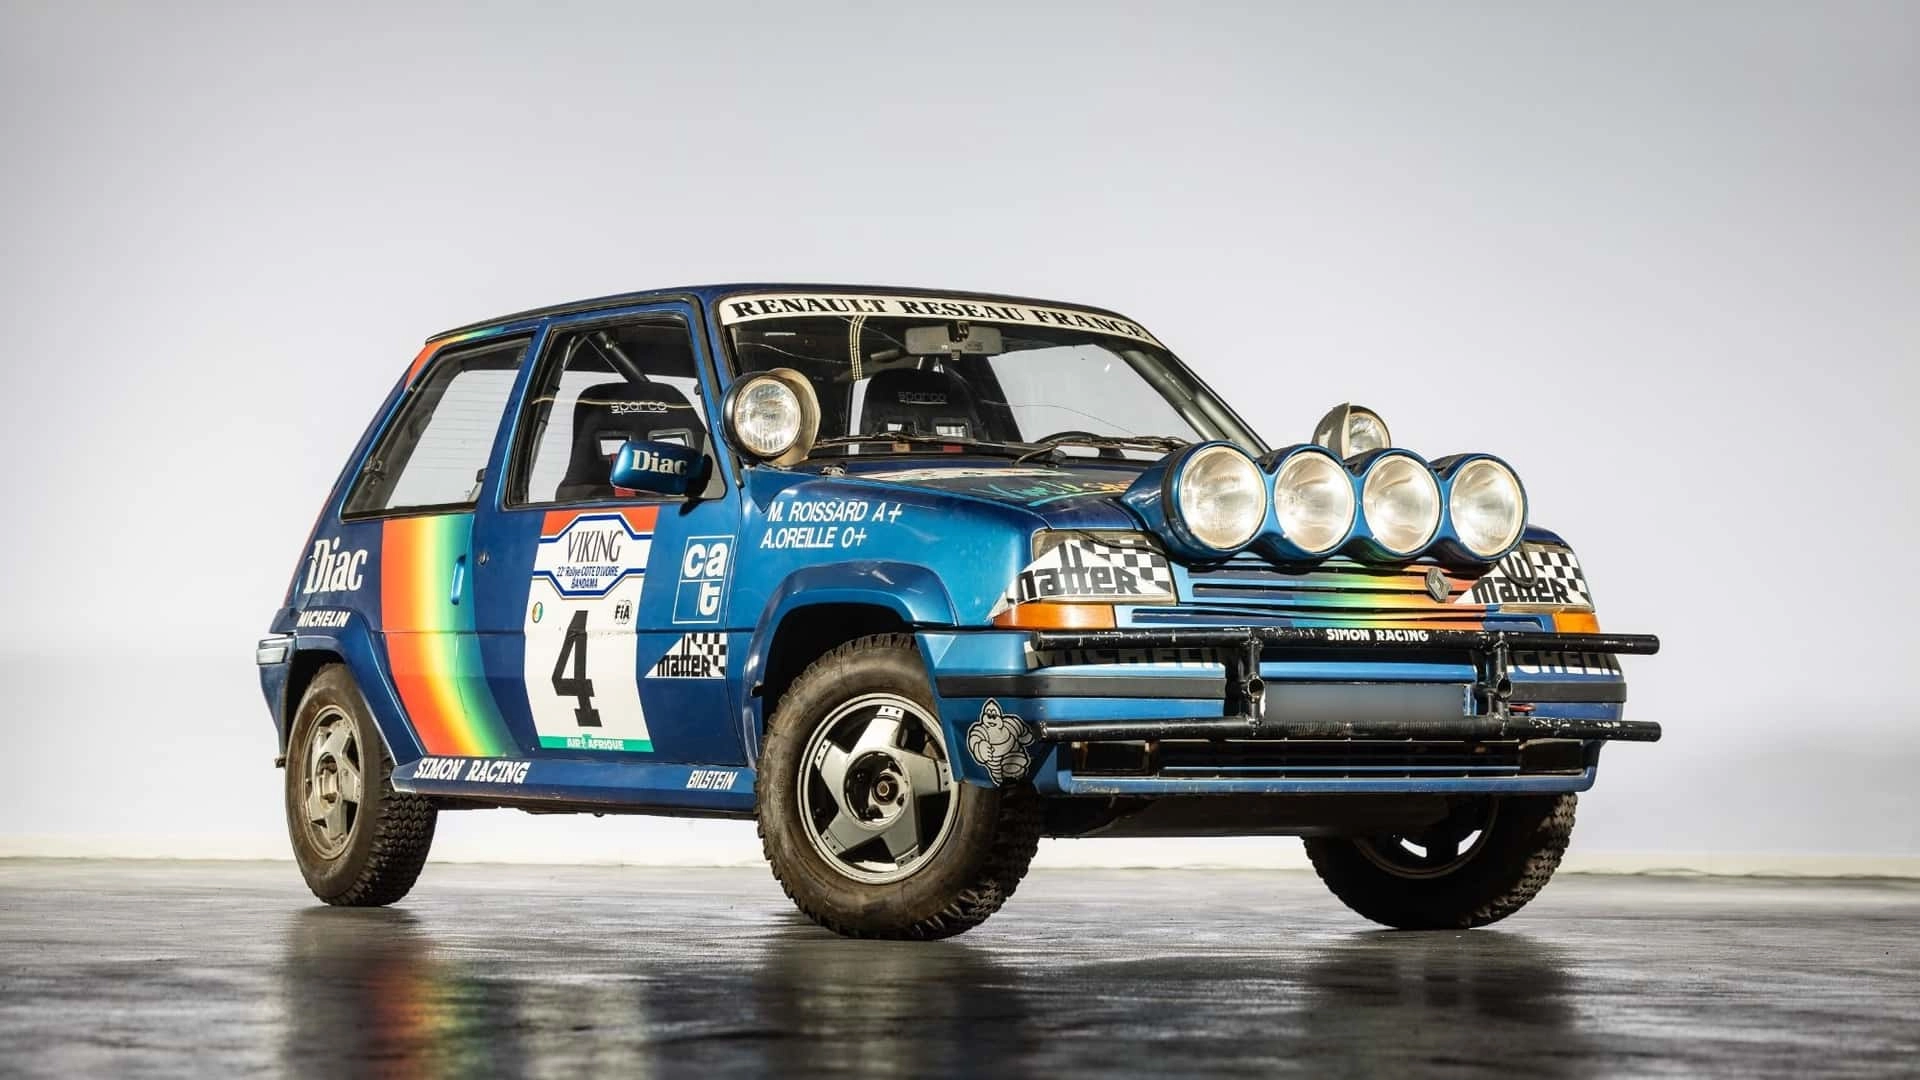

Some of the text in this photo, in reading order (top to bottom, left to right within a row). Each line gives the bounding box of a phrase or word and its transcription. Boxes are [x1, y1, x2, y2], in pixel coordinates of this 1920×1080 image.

[729, 298, 1150, 340] RENAULT RESEAU FRANCE
[610, 401, 668, 415] sparco
[631, 450, 688, 475] Diac
[788, 502, 868, 522] ROISSARD
[872, 502, 903, 524] A+
[568, 529, 624, 562] VIKING
[303, 536, 368, 595] Diac
[296, 610, 351, 627] MICHELIN
[1327, 629, 1429, 642] SIMON RACING
[551, 610, 603, 728] 4
[565, 737, 624, 750] AIR AFRIQUE
[413, 758, 531, 784] SIMON RACING
[686, 769, 738, 790] BILSTEIN
